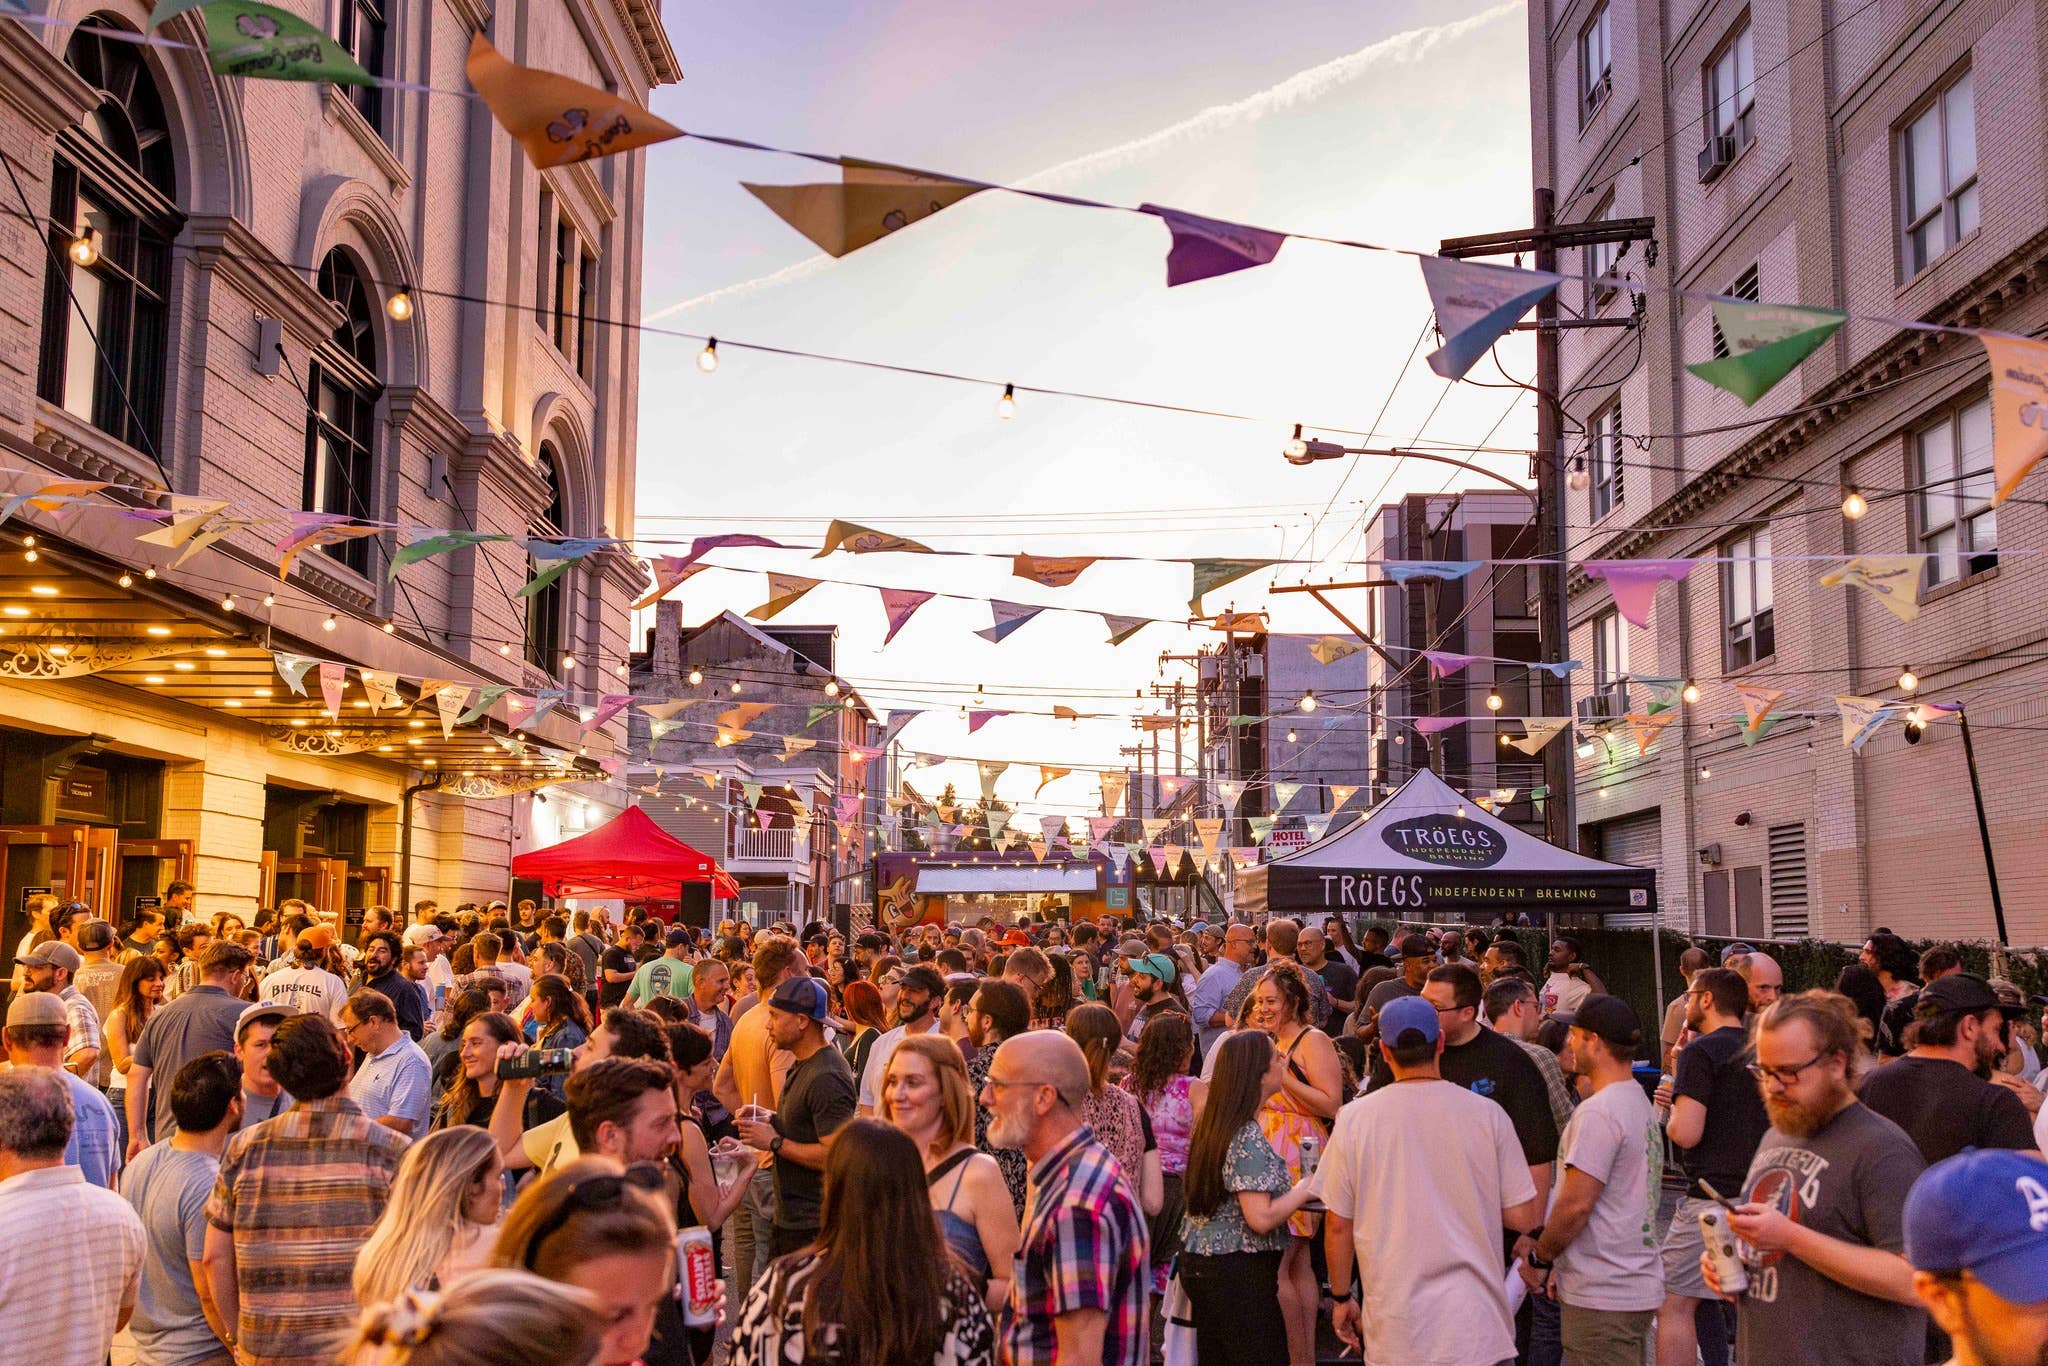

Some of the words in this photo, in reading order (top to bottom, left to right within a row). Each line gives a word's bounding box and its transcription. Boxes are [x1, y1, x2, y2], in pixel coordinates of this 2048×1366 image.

[1273, 831, 1305, 841] HOTEL
[1395, 827, 1491, 847] TRÖEGS
[1406, 847, 1494, 855] INDEPENDENT
[1319, 873, 1423, 907] TRÖEGS
[1429, 887, 1524, 897] INDEPENDENT
[1536, 889, 1597, 899] BREWING
[272, 983, 321, 997] BIRDWELL
[693, 1253, 707, 1302] ARTOIS
[703, 1252, 714, 1299] STELLA
